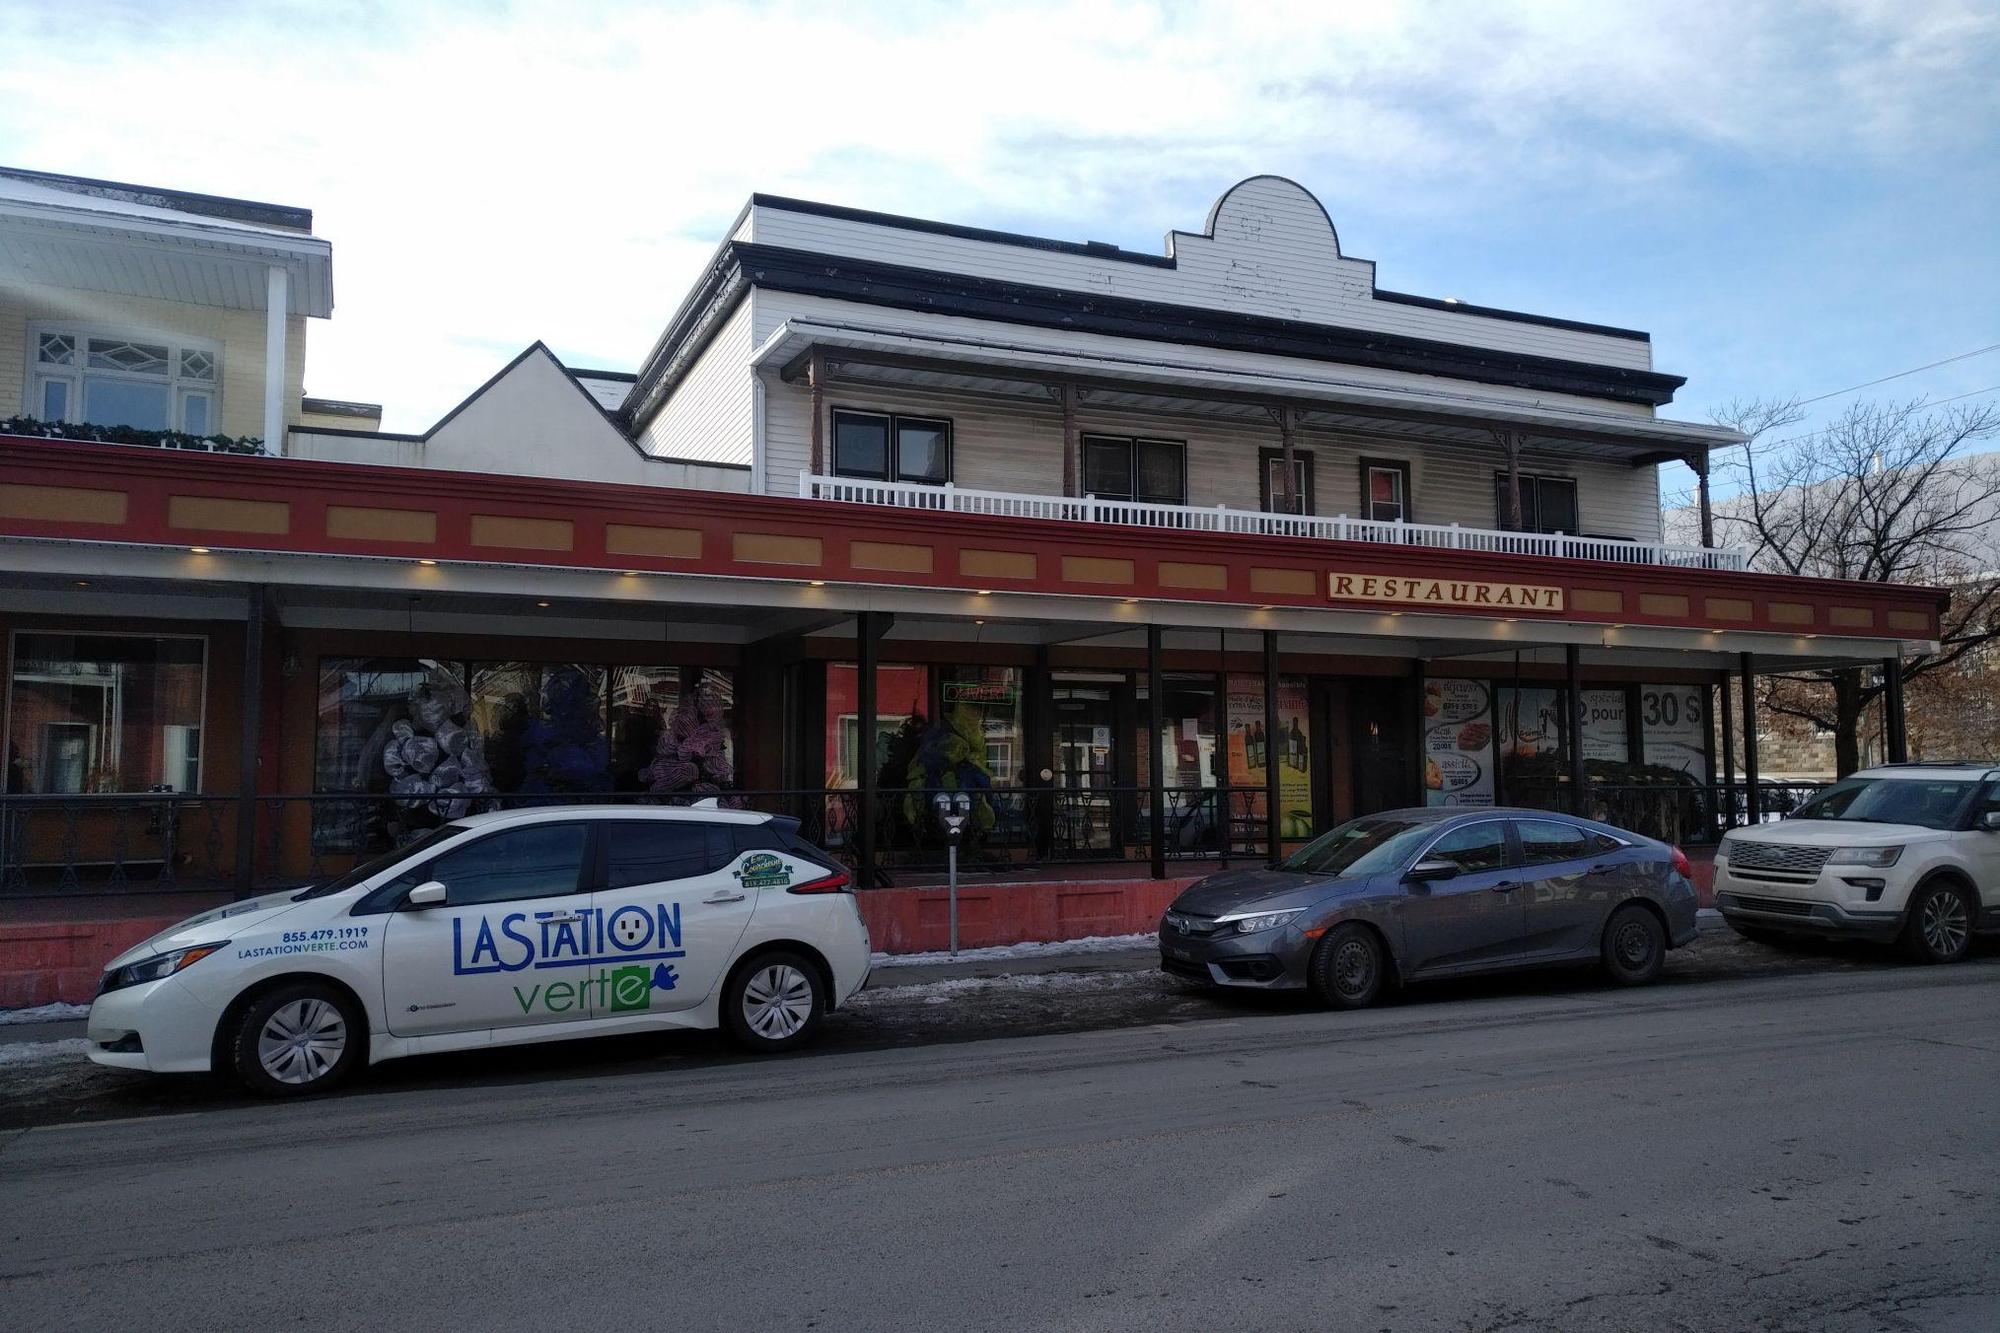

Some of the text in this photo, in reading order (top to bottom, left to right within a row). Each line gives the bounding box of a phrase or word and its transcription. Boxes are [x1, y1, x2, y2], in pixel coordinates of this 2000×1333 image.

[1335, 576, 1559, 607] RESTAURANT
[1591, 708, 1625, 723] pour
[1643, 691, 1679, 727] 30
[282, 927, 369, 943] 855.479.1919
[238, 940, 369, 959] LASTATIONVERTE.COM
[513, 968, 647, 1014] verte
